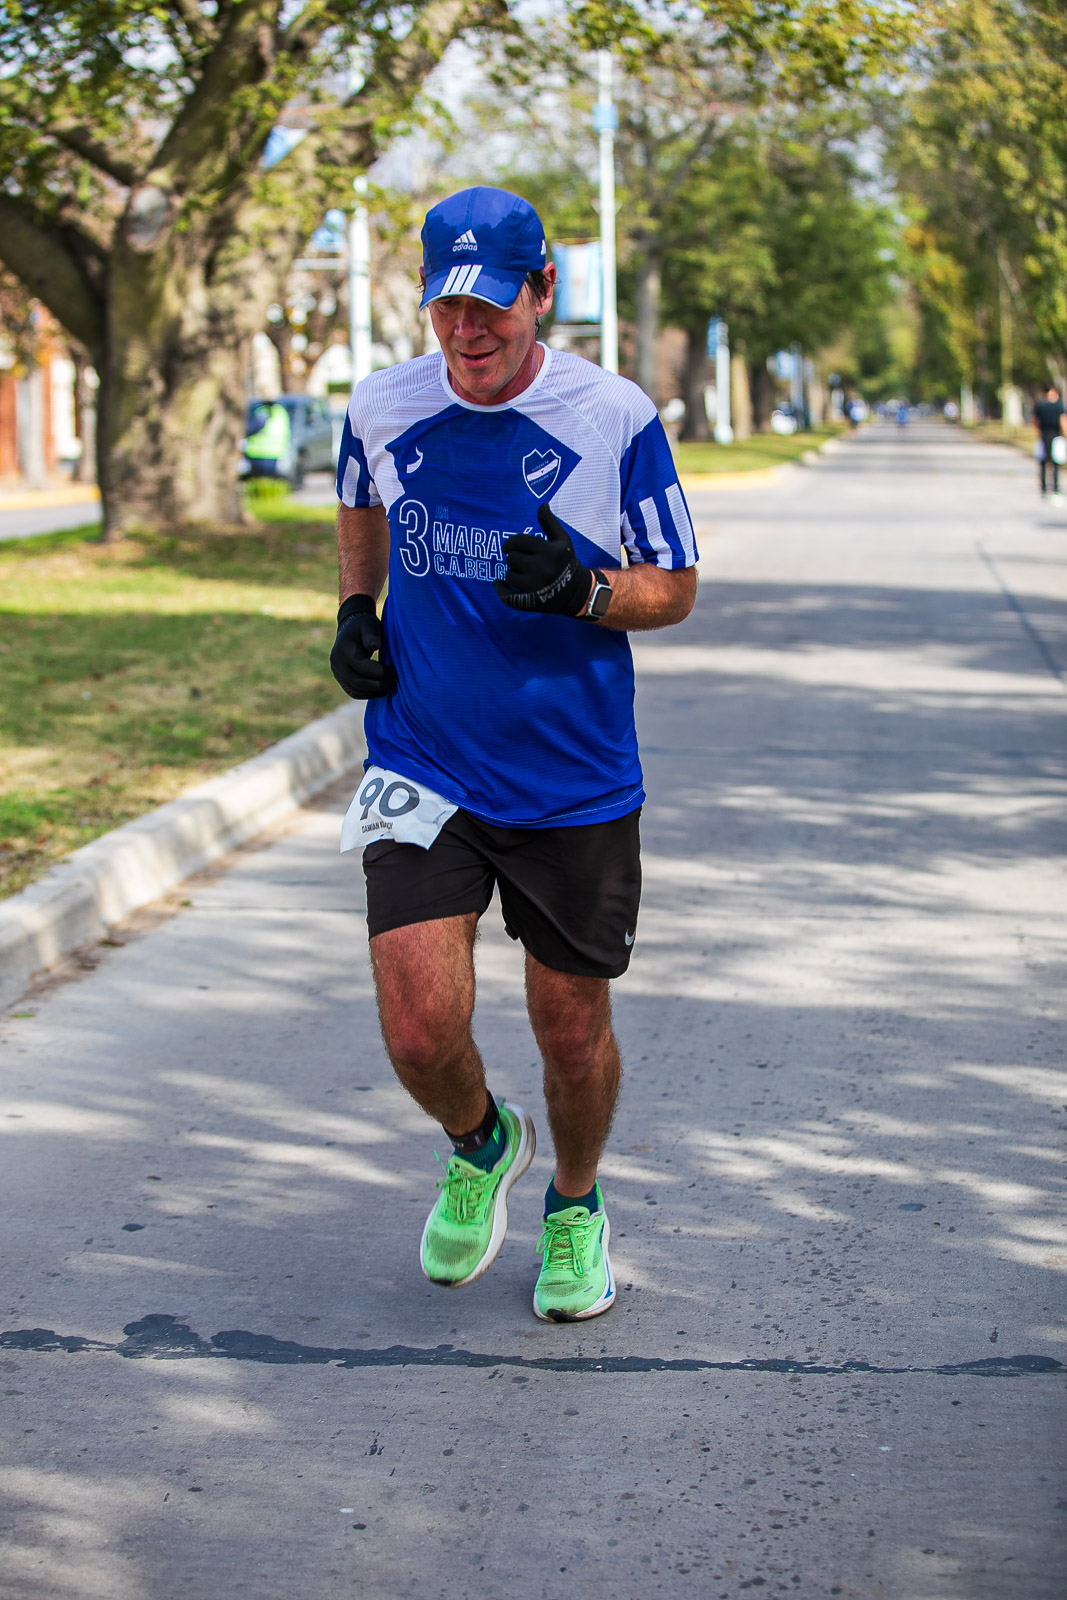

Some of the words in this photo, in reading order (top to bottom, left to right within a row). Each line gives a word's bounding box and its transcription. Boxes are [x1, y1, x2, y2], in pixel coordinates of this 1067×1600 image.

[453, 243, 478, 252] adidas
[399, 500, 430, 577] 3
[433, 521, 549, 561] MARA
[434, 553, 508, 582] C.A.BELG
[360, 777, 420, 820] 90
